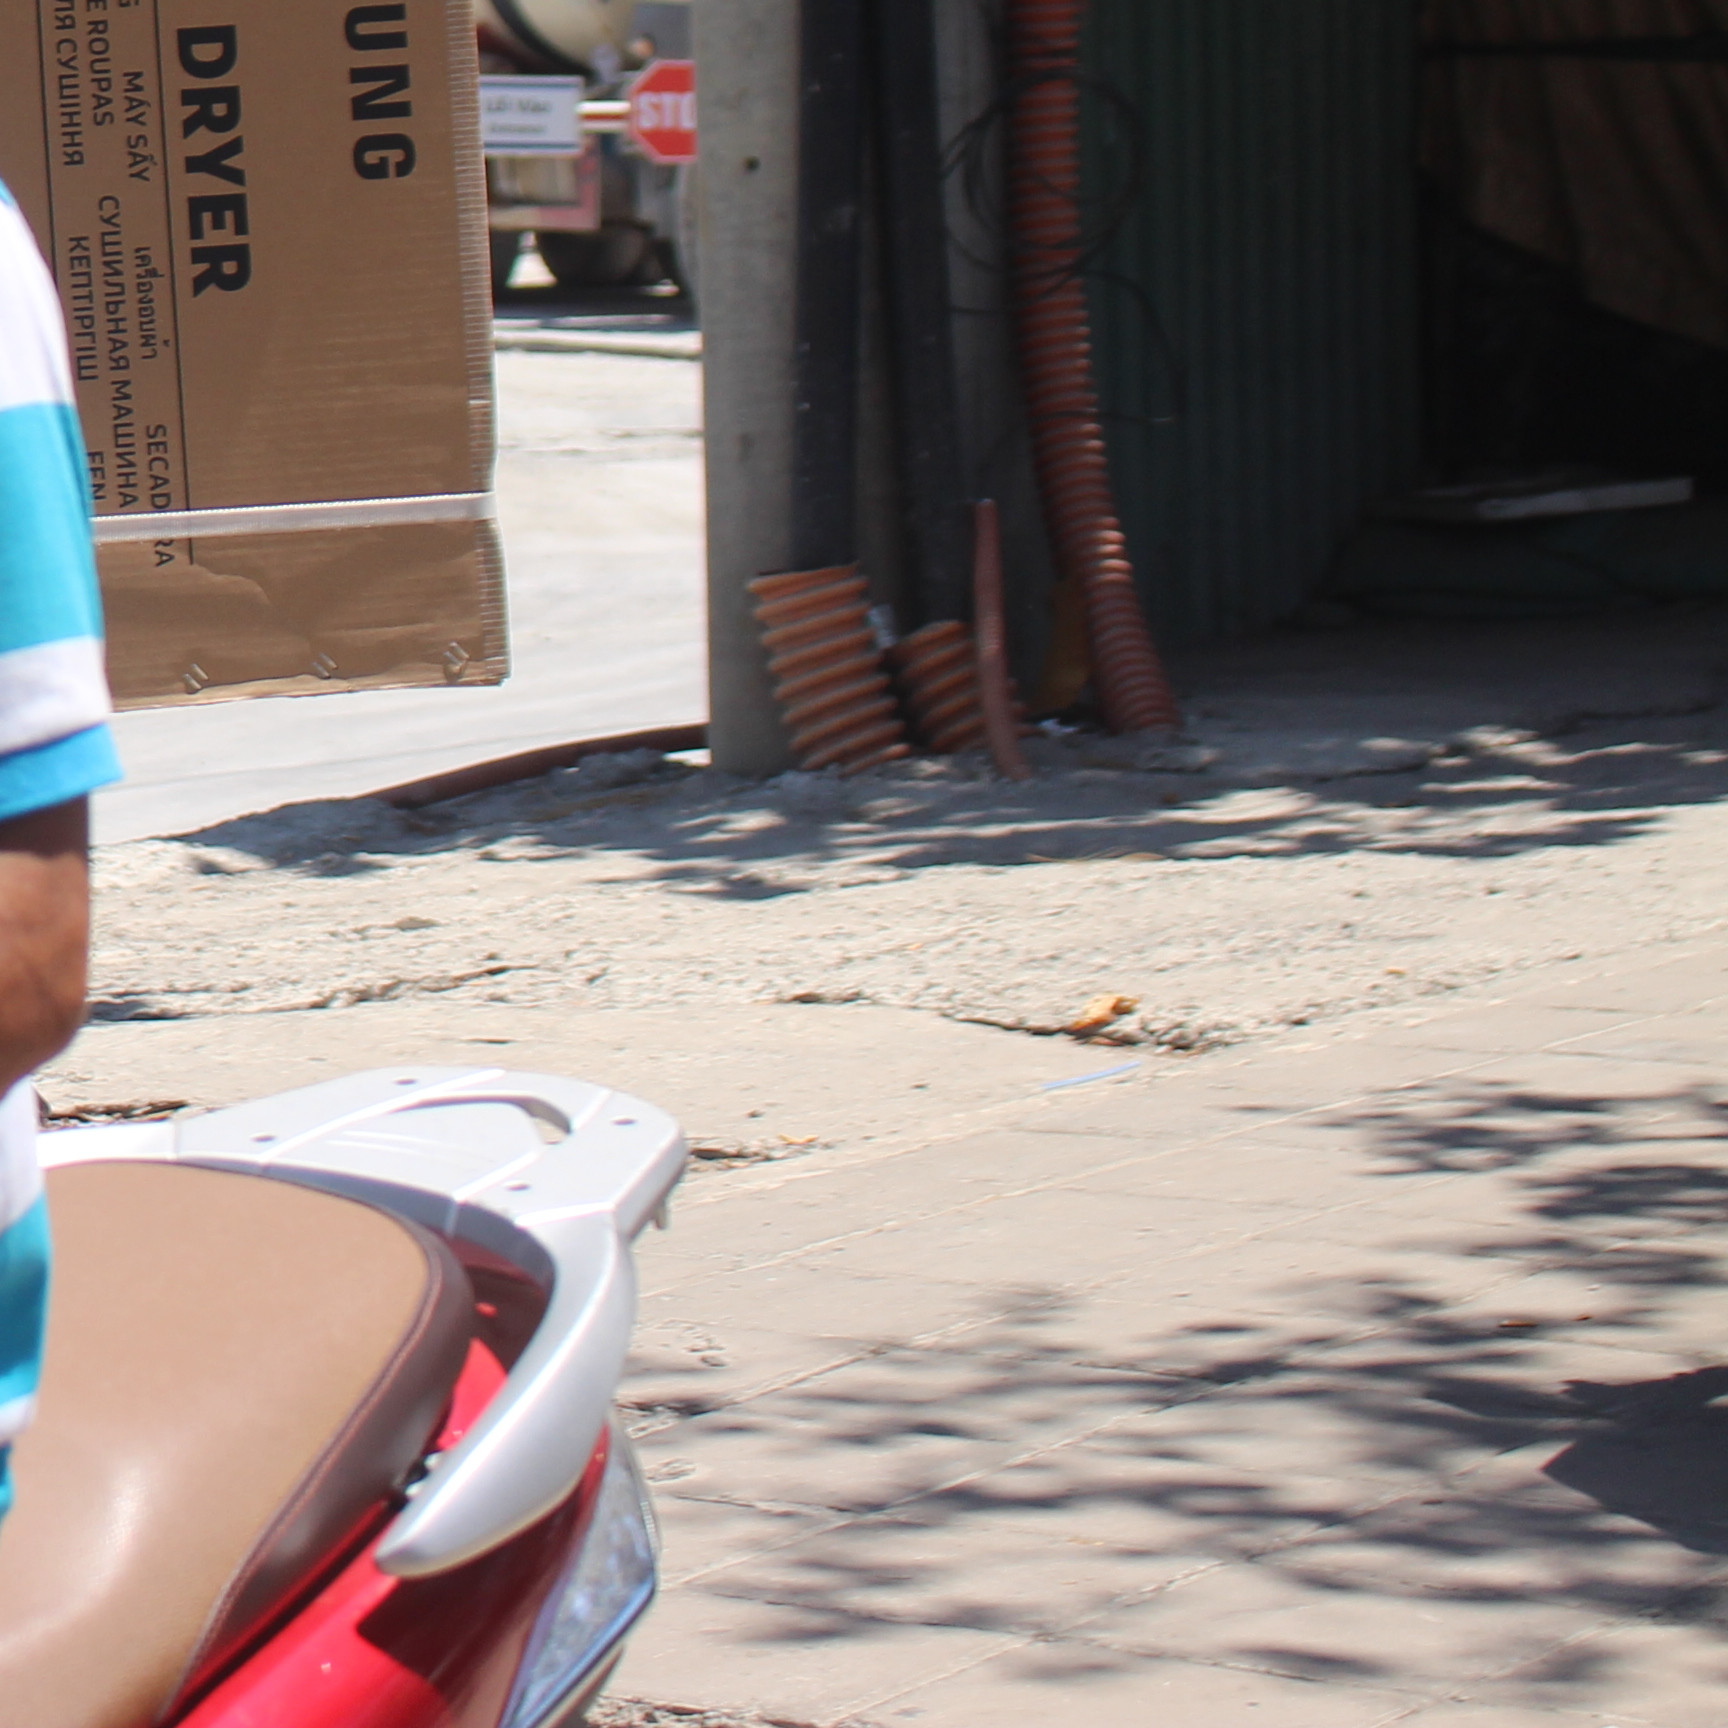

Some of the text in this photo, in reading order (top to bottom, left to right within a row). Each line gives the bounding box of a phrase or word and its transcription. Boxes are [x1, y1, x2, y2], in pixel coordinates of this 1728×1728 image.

[56, 38, 85, 167] СУШІННЯ
[87, 19, 114, 127] ROUPAS
[122, 71, 158, 182] MÁY SẤY
[638, 91, 697, 129] STO
[177, 25, 252, 298] DRYER
[68, 236, 99, 382] КЕПТІРГІШ
[98, 196, 139, 508] СУШИЛЬНАЯ МАШИНА
[134, 246, 170, 360] เครื่องอบผ้า
[146, 424, 175, 567] SECADRA
